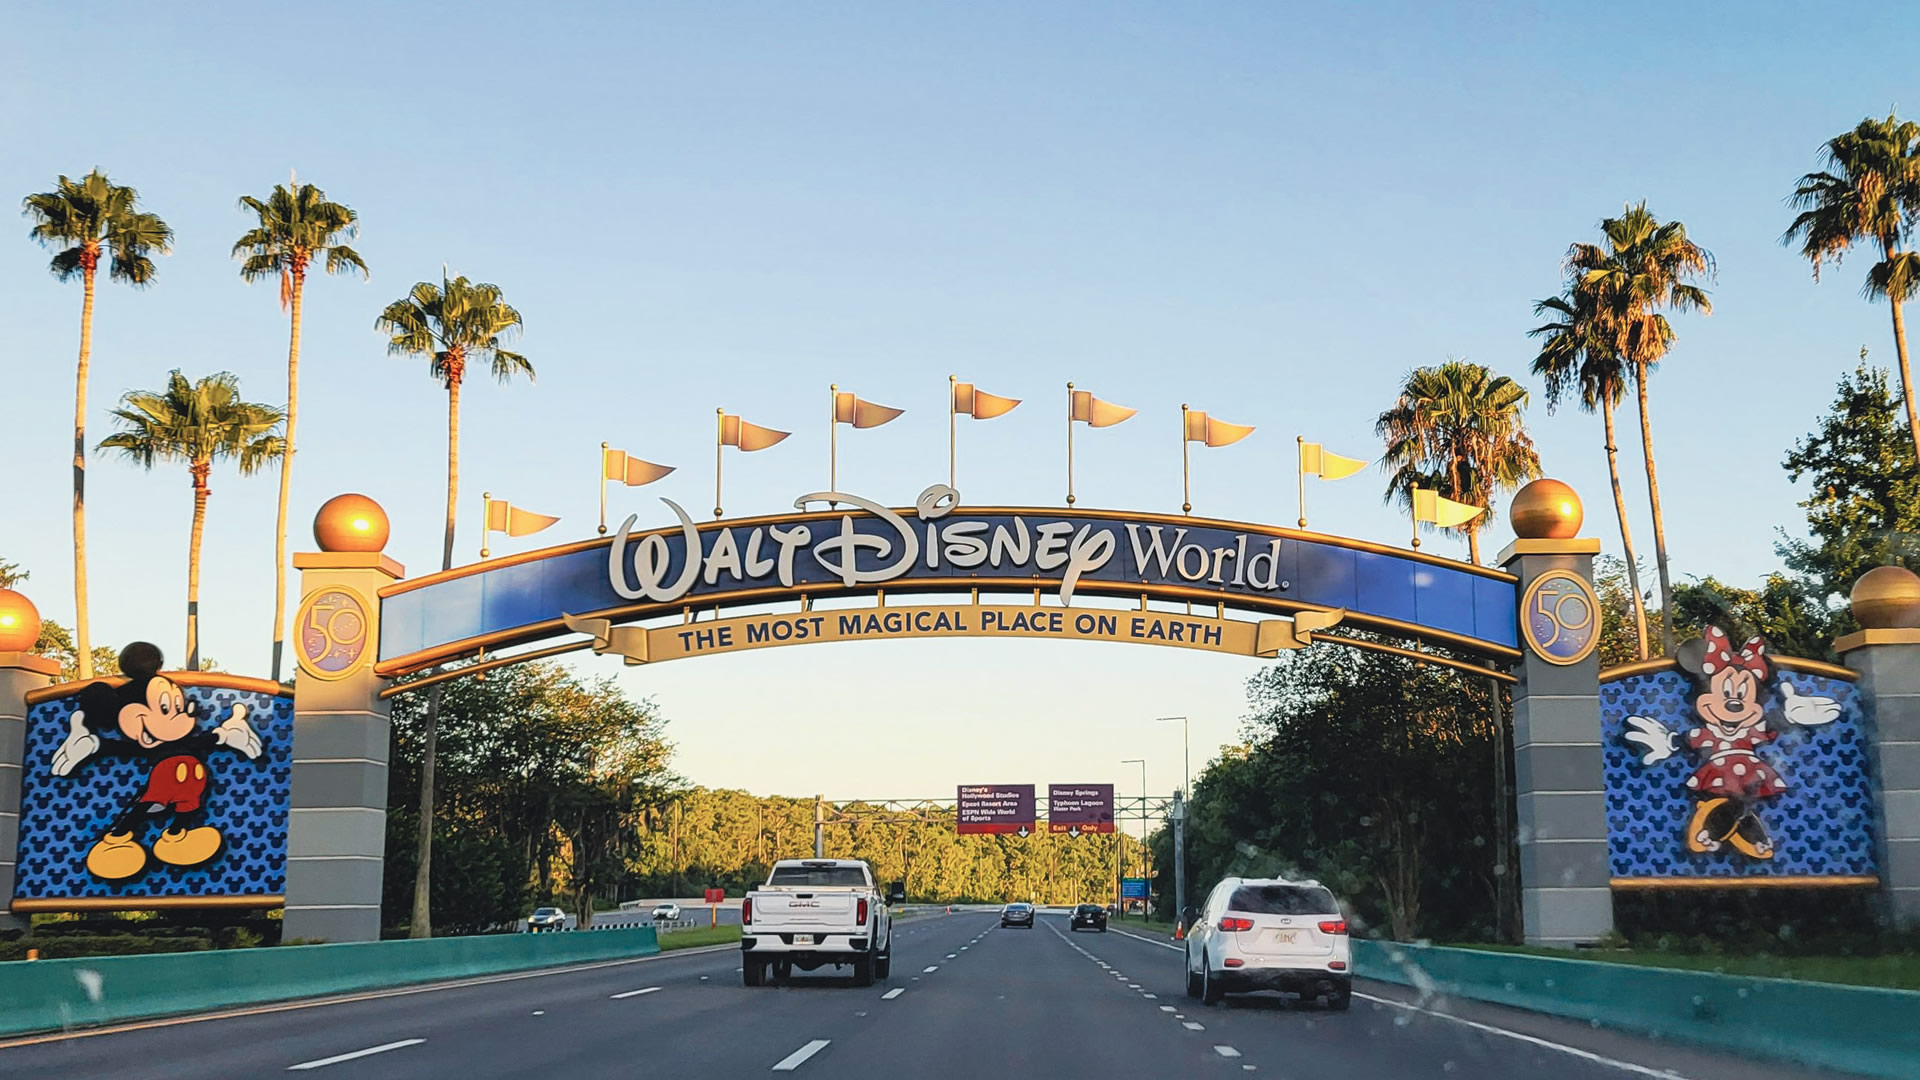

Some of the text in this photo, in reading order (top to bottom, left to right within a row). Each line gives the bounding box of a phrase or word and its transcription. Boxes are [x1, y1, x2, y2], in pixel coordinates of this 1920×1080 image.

[310, 604, 366, 664] 50
[678, 611, 1222, 651] THE MOST MAGICAL PLACE ON EARTH
[1537, 590, 1592, 648] 50
